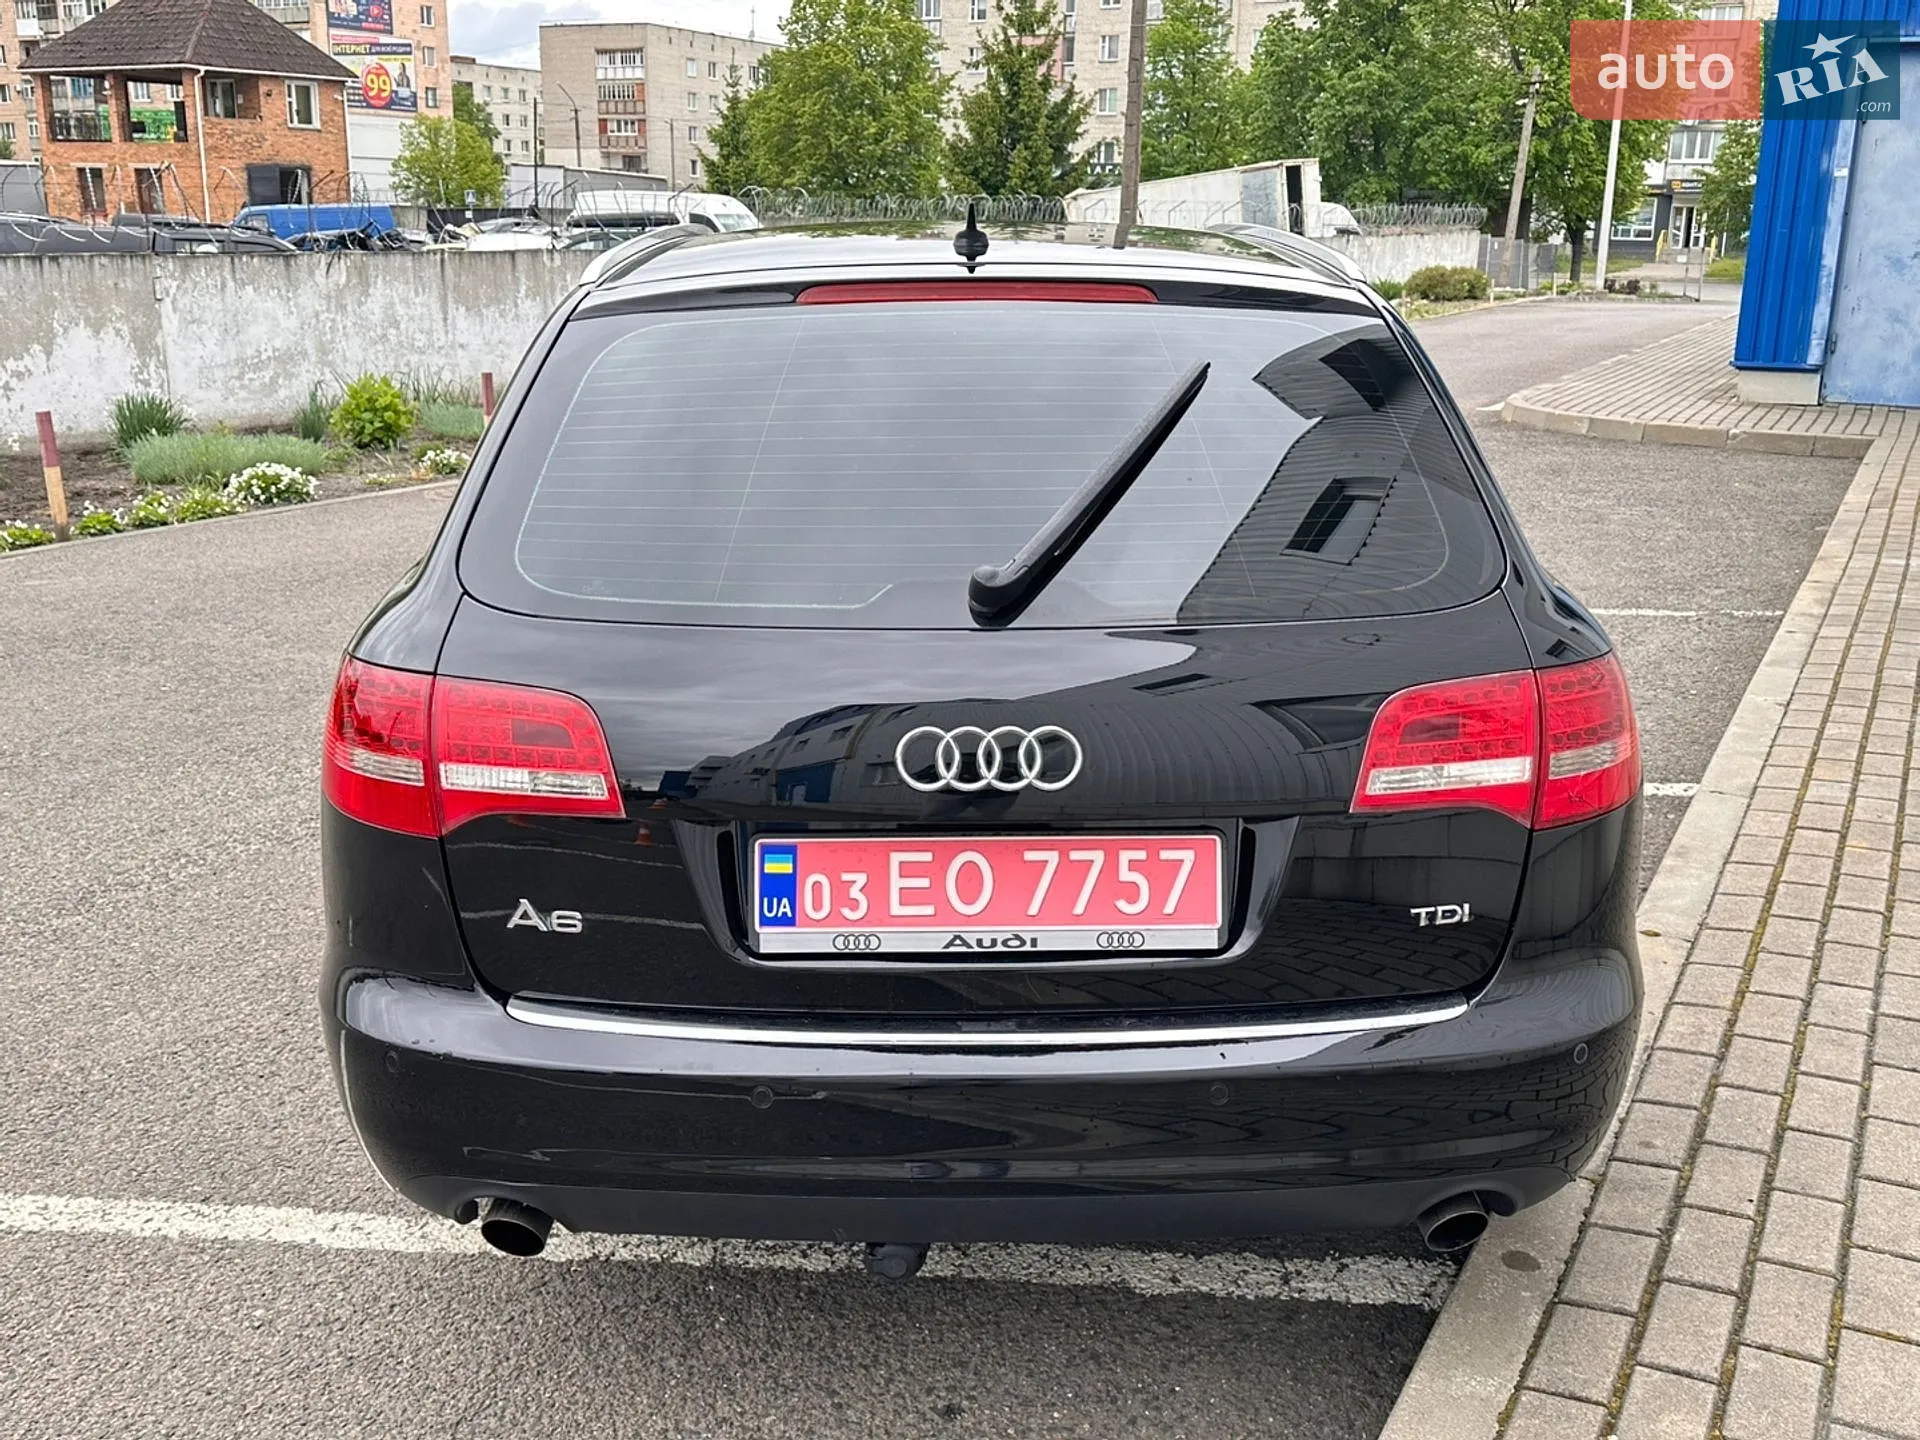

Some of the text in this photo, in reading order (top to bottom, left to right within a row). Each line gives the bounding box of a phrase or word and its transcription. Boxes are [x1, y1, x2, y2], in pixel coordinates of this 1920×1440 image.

[366, 74, 392, 97] 99
[803, 848, 1197, 922] 03 EO 7757
[506, 898, 583, 934] A6
[763, 896, 792, 918] UA
[1410, 903, 1470, 927] TDI
[941, 933, 1038, 951] Audi
